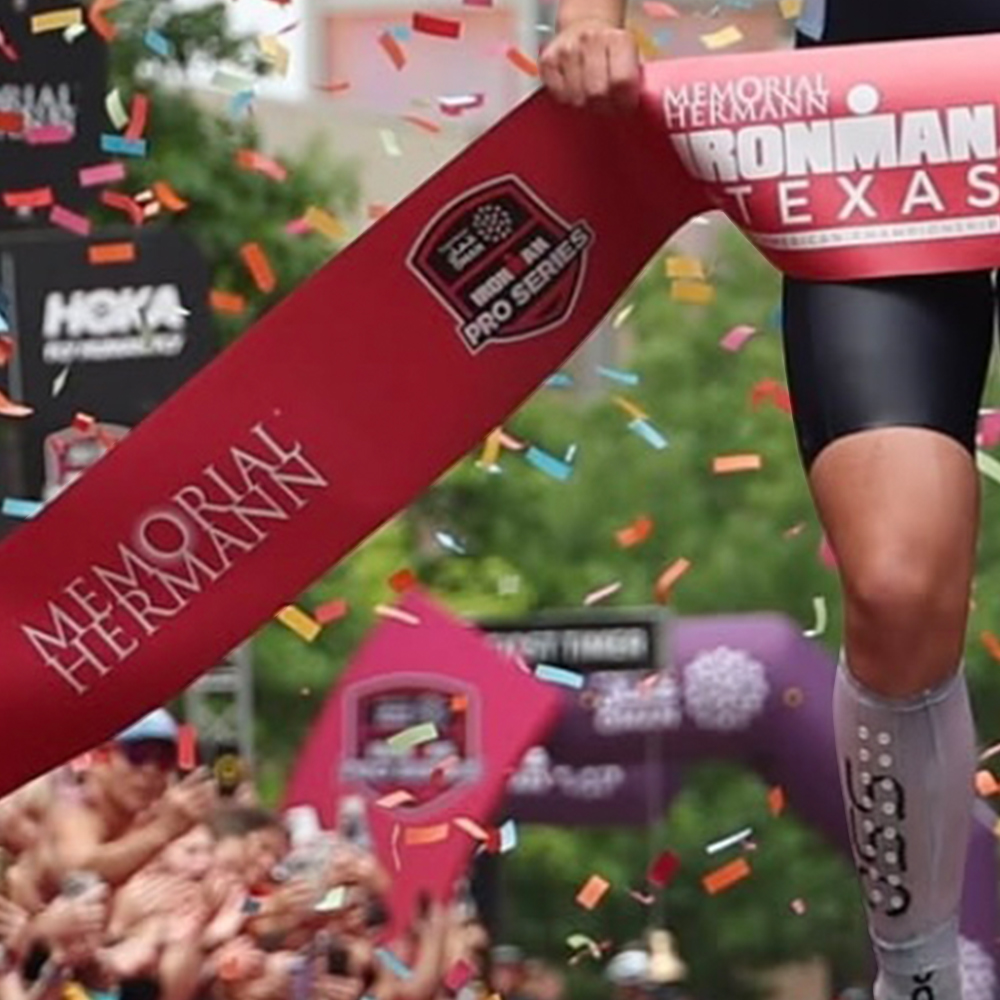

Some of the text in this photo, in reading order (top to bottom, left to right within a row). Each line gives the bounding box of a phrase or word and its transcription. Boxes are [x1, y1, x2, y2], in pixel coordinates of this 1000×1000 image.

[662, 74, 828, 108] MEMORIAL
[665, 89, 831, 129] HERMANN
[669, 84, 1000, 183] IRONMAN
[43, 284, 185, 338] HOKA
[464, 299, 513, 346] PRO
[510, 228, 589, 306] SERIES
[21, 423, 303, 666] MEMORIAL
[47, 449, 329, 696] HERMANN
